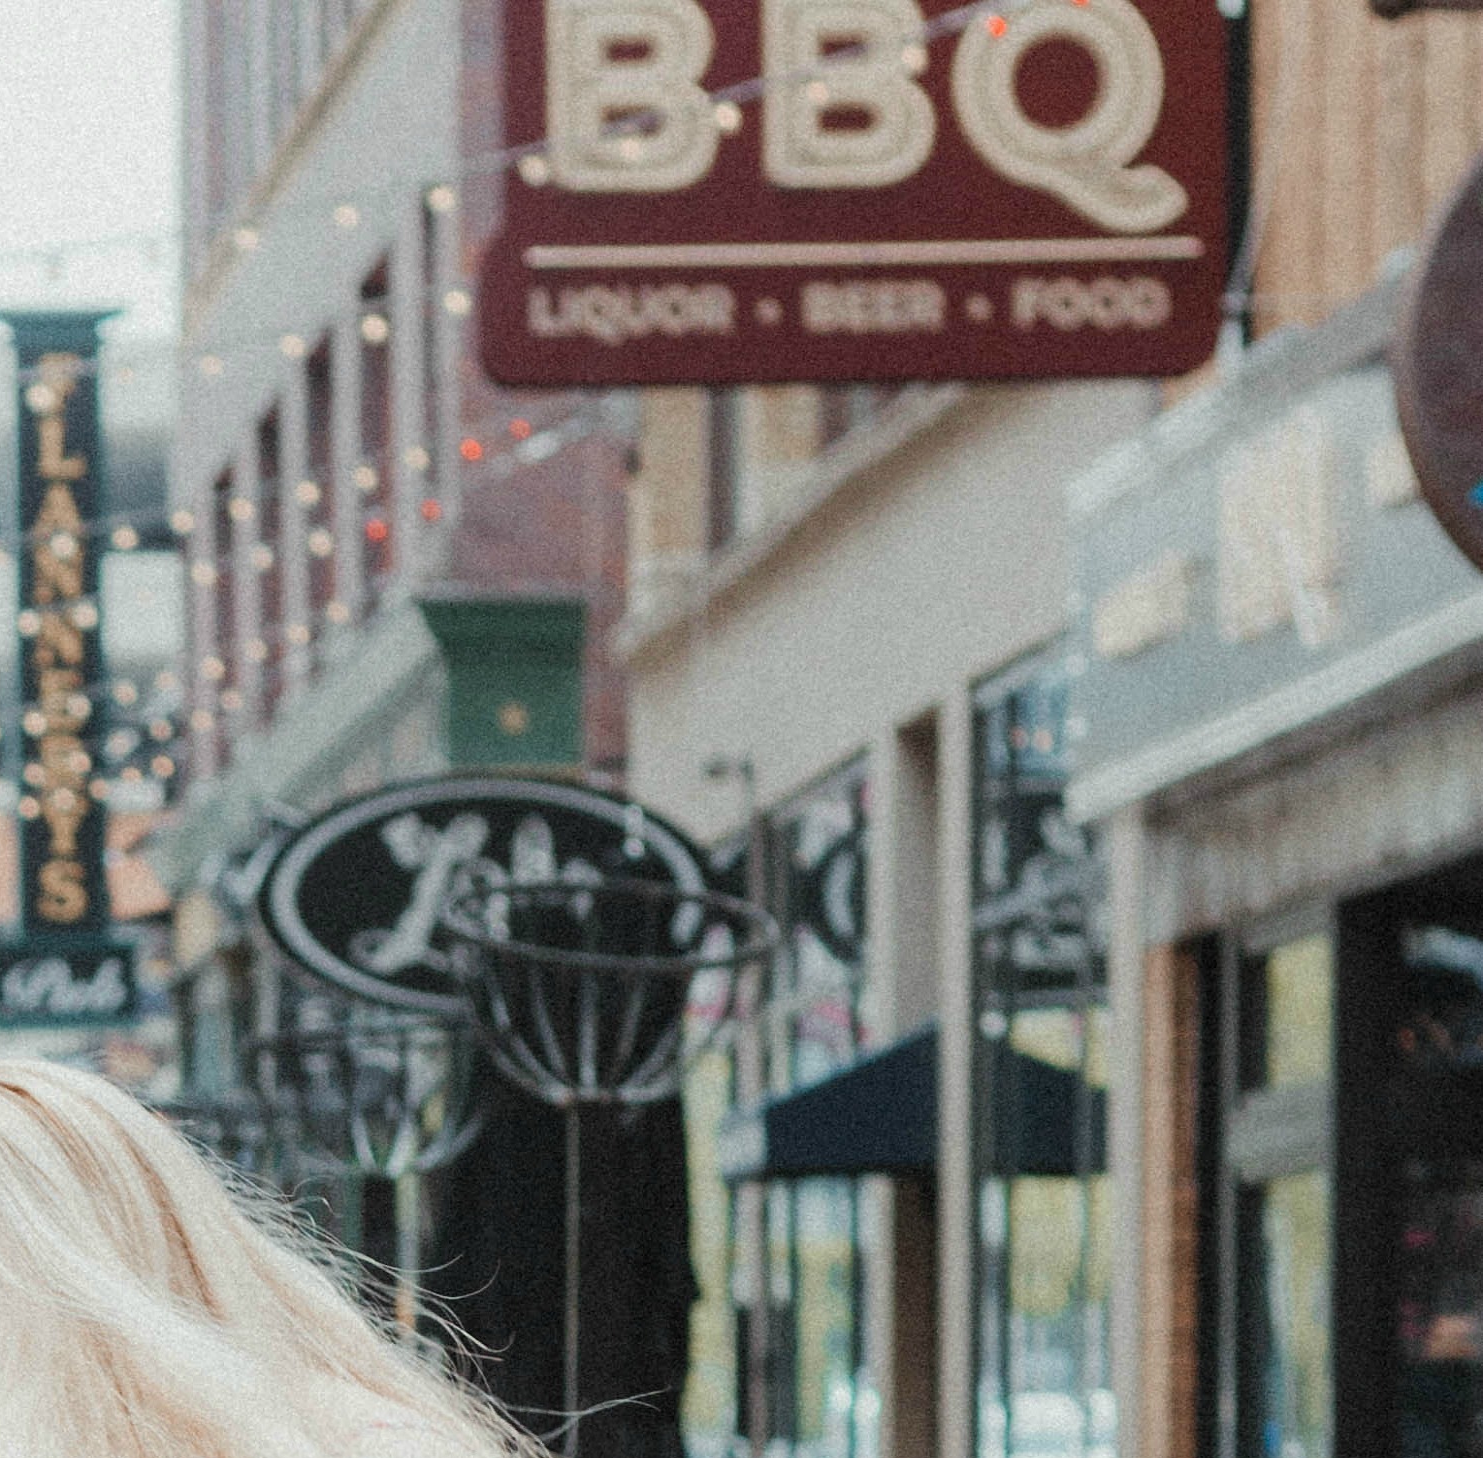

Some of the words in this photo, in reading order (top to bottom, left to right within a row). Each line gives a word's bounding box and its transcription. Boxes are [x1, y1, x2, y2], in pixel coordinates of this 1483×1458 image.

[545, 0, 1188, 232] BBQ
[528, 283, 734, 346] LIQUOR
[801, 280, 943, 333] BEER
[1011, 276, 1171, 331] FOOD
